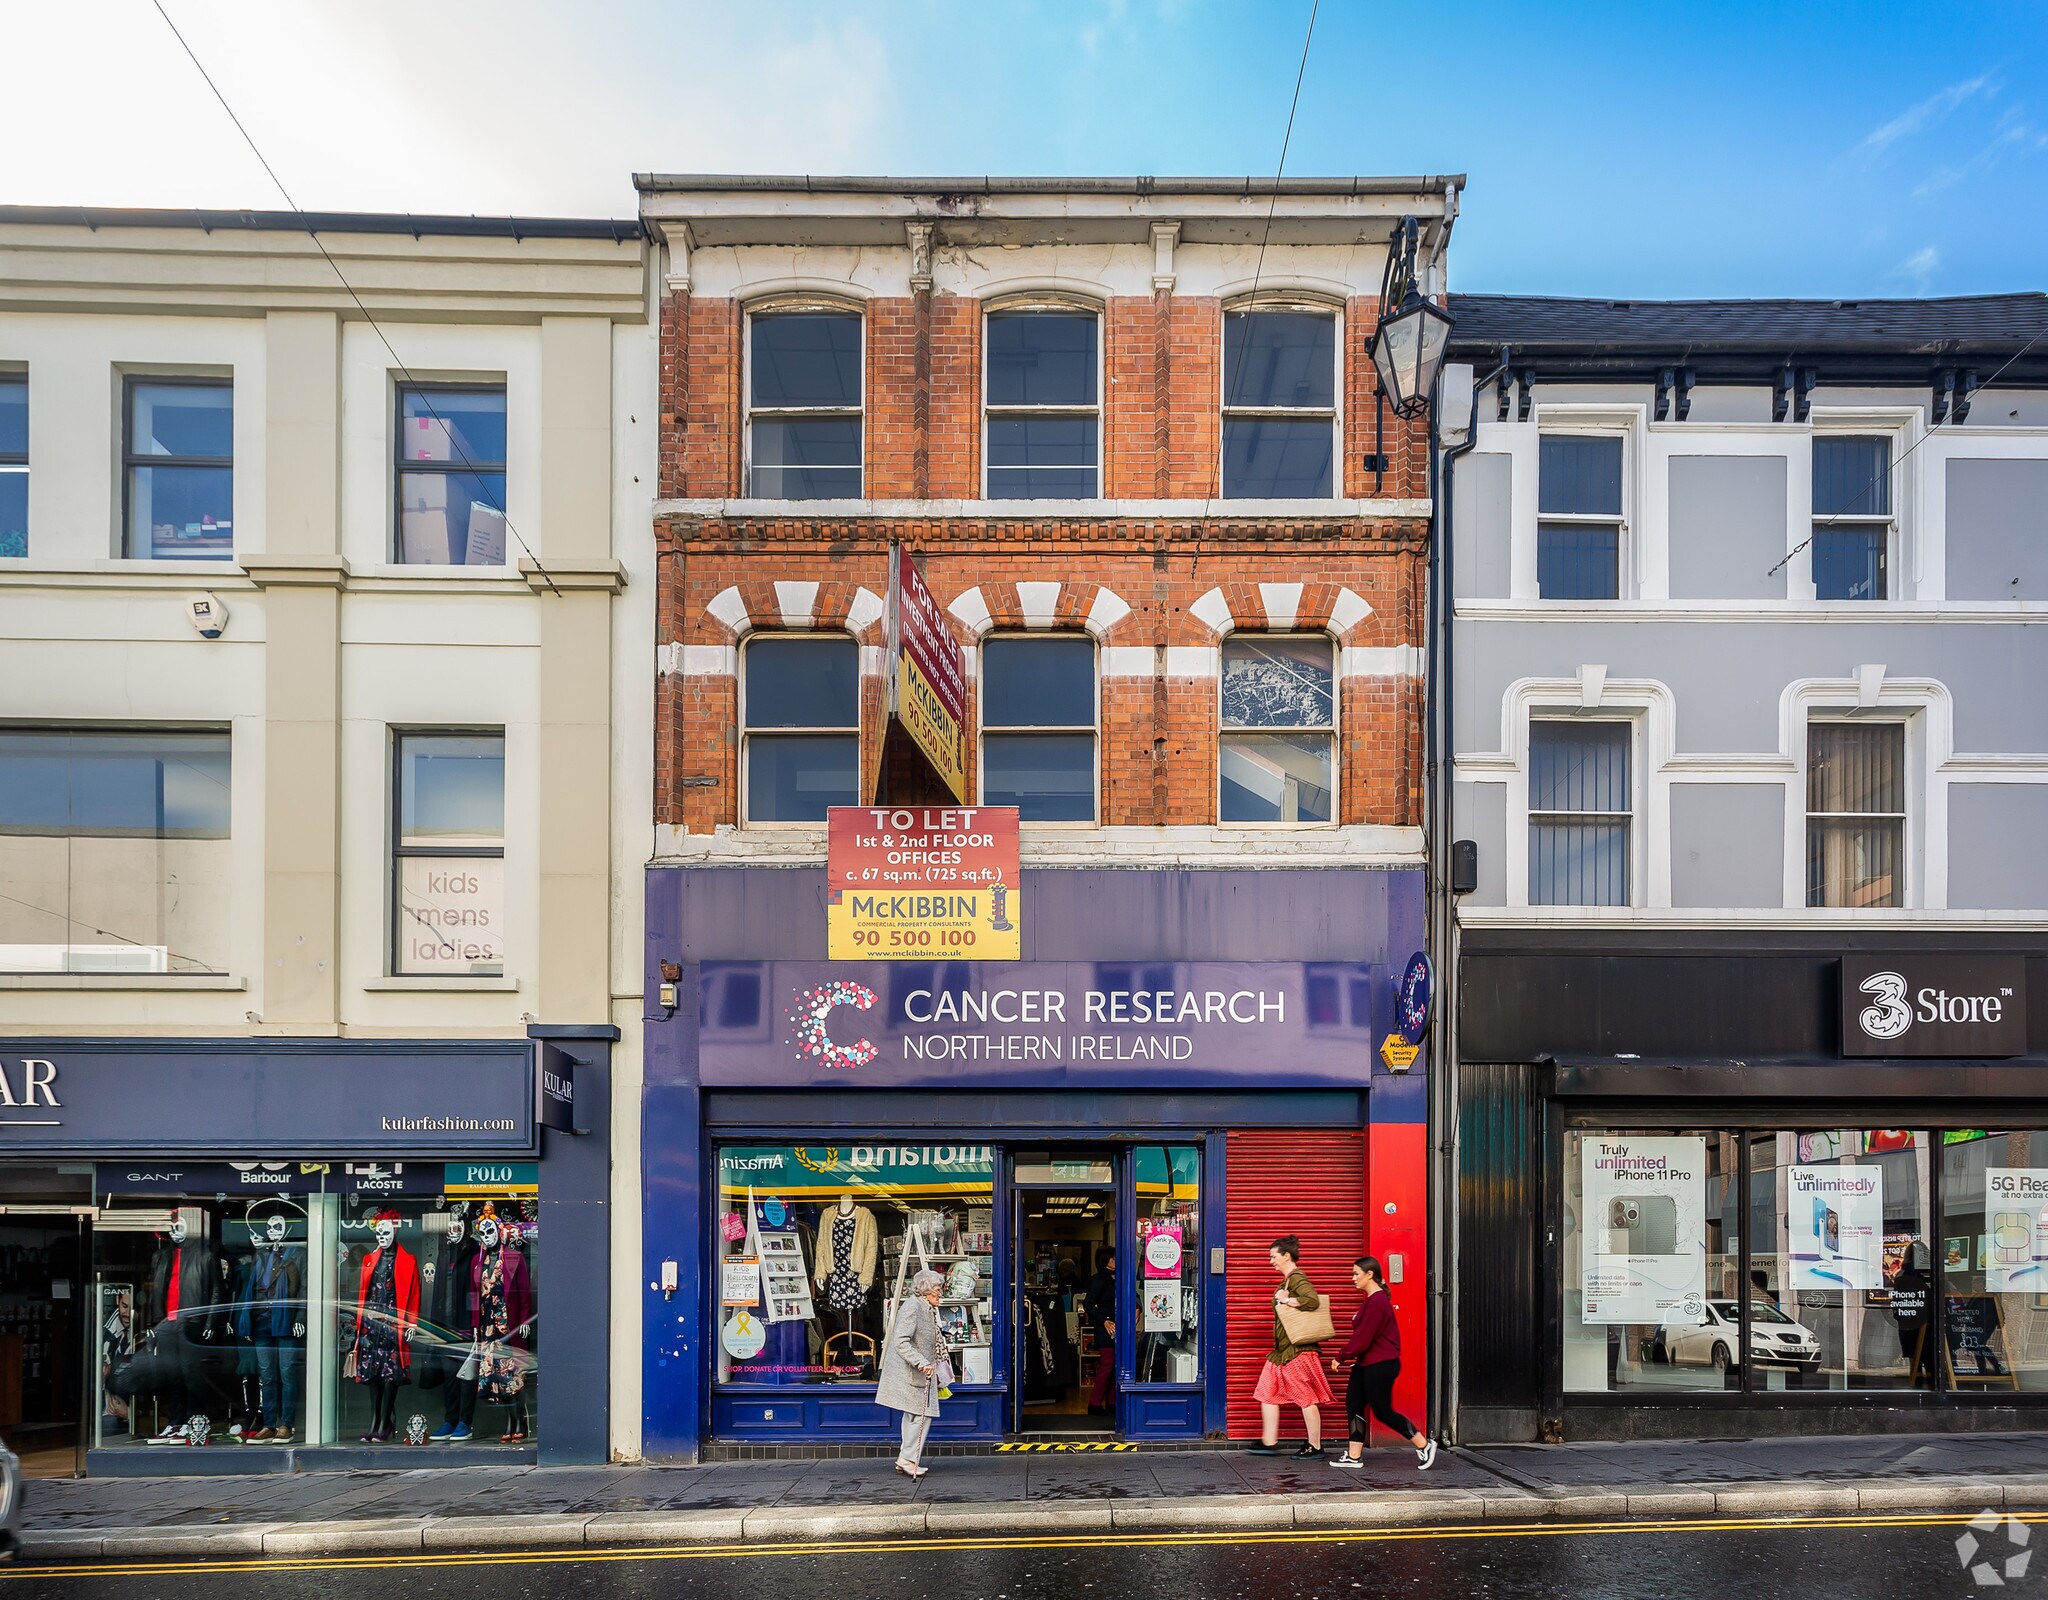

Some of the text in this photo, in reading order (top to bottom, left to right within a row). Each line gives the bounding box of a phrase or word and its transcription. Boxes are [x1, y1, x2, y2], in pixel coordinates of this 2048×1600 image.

[912, 570, 957, 662] FOR SALE
[901, 585, 965, 700] INVESTMENT PROPERTY
[903, 620, 963, 722] (TENANTS NOT AFFECTED)
[907, 660, 953, 747] McKIBBIN
[908, 701, 952, 774] 90 500 100
[869, 810, 977, 830] TO LET
[882, 835, 894, 848] &
[899, 835, 928, 848] 2nd
[933, 834, 994, 848] FLOOR
[887, 851, 962, 865] OFFICES
[428, 871, 479, 894] kids
[846, 867, 1002, 884] c. 67 sq.m. (725 sq.ft.)
[852, 896, 976, 918] McKIBBIN
[417, 908, 490, 926] mens
[852, 930, 977, 946] 90 500 100
[412, 938, 494, 961] ladies
[904, 990, 1286, 1023] CANCER RESEARCH
[903, 1035, 1193, 1061] NORTHERN IRELAND
[544, 1070, 573, 1100] KULAR
[382, 1116, 515, 1131] kularfashion.com
[1600, 1144, 1629, 1157] Truly
[1595, 1156, 1666, 1169] unlimited
[127, 1173, 184, 1182] GANT
[241, 1172, 292, 1183] Barbour
[467, 1166, 513, 1182] POLO
[1614, 1170, 1691, 1180] iPhone 11 Pro
[1794, 1172, 1815, 1181] Live
[356, 1181, 404, 1189] LACOSTE
[1797, 1178, 1875, 1193] unlimitedly
[1991, 1176, 2015, 1192] 5G
[1890, 1299, 1925, 1307] available
[1898, 1308, 1917, 1316] here
[1957, 1316, 1975, 1324] HOME
